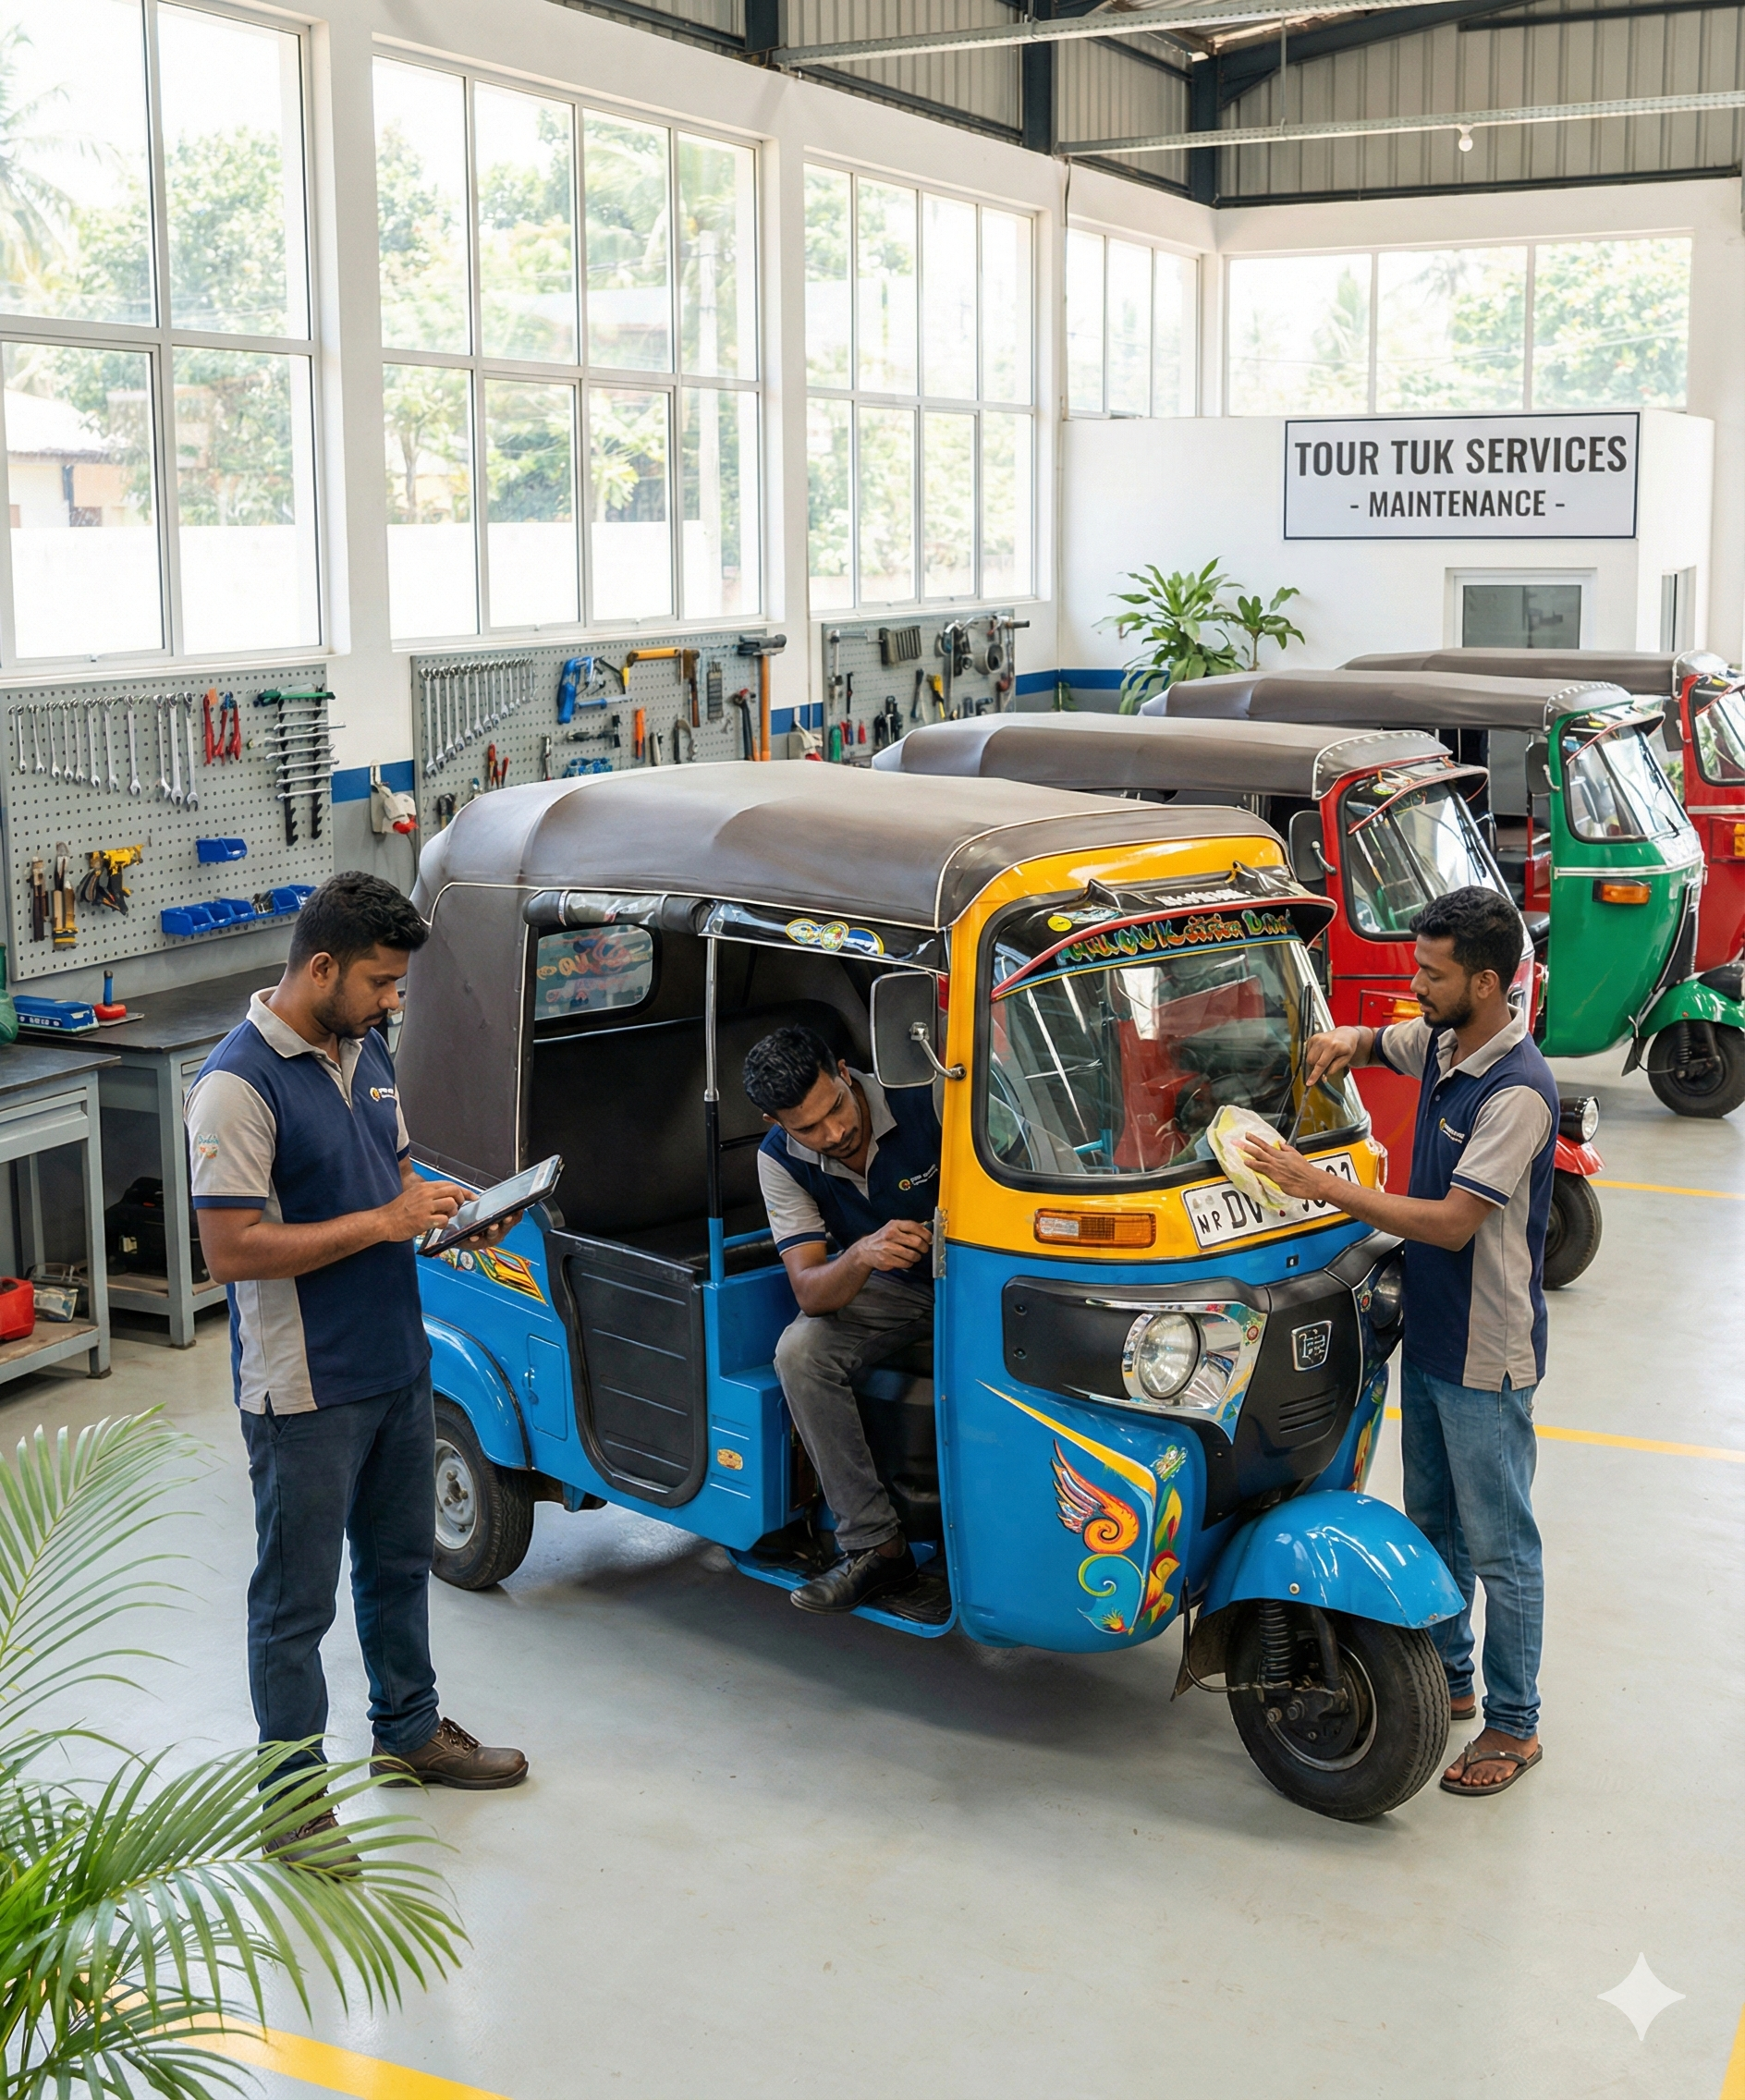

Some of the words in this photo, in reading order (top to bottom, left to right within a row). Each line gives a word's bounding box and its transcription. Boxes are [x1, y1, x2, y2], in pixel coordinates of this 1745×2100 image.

[1295, 441, 1379, 476] TOUR
[1391, 439, 1455, 475] TUK
[1466, 435, 1628, 474] SERVICES
[1369, 490, 1546, 518] MAINTENANCE
